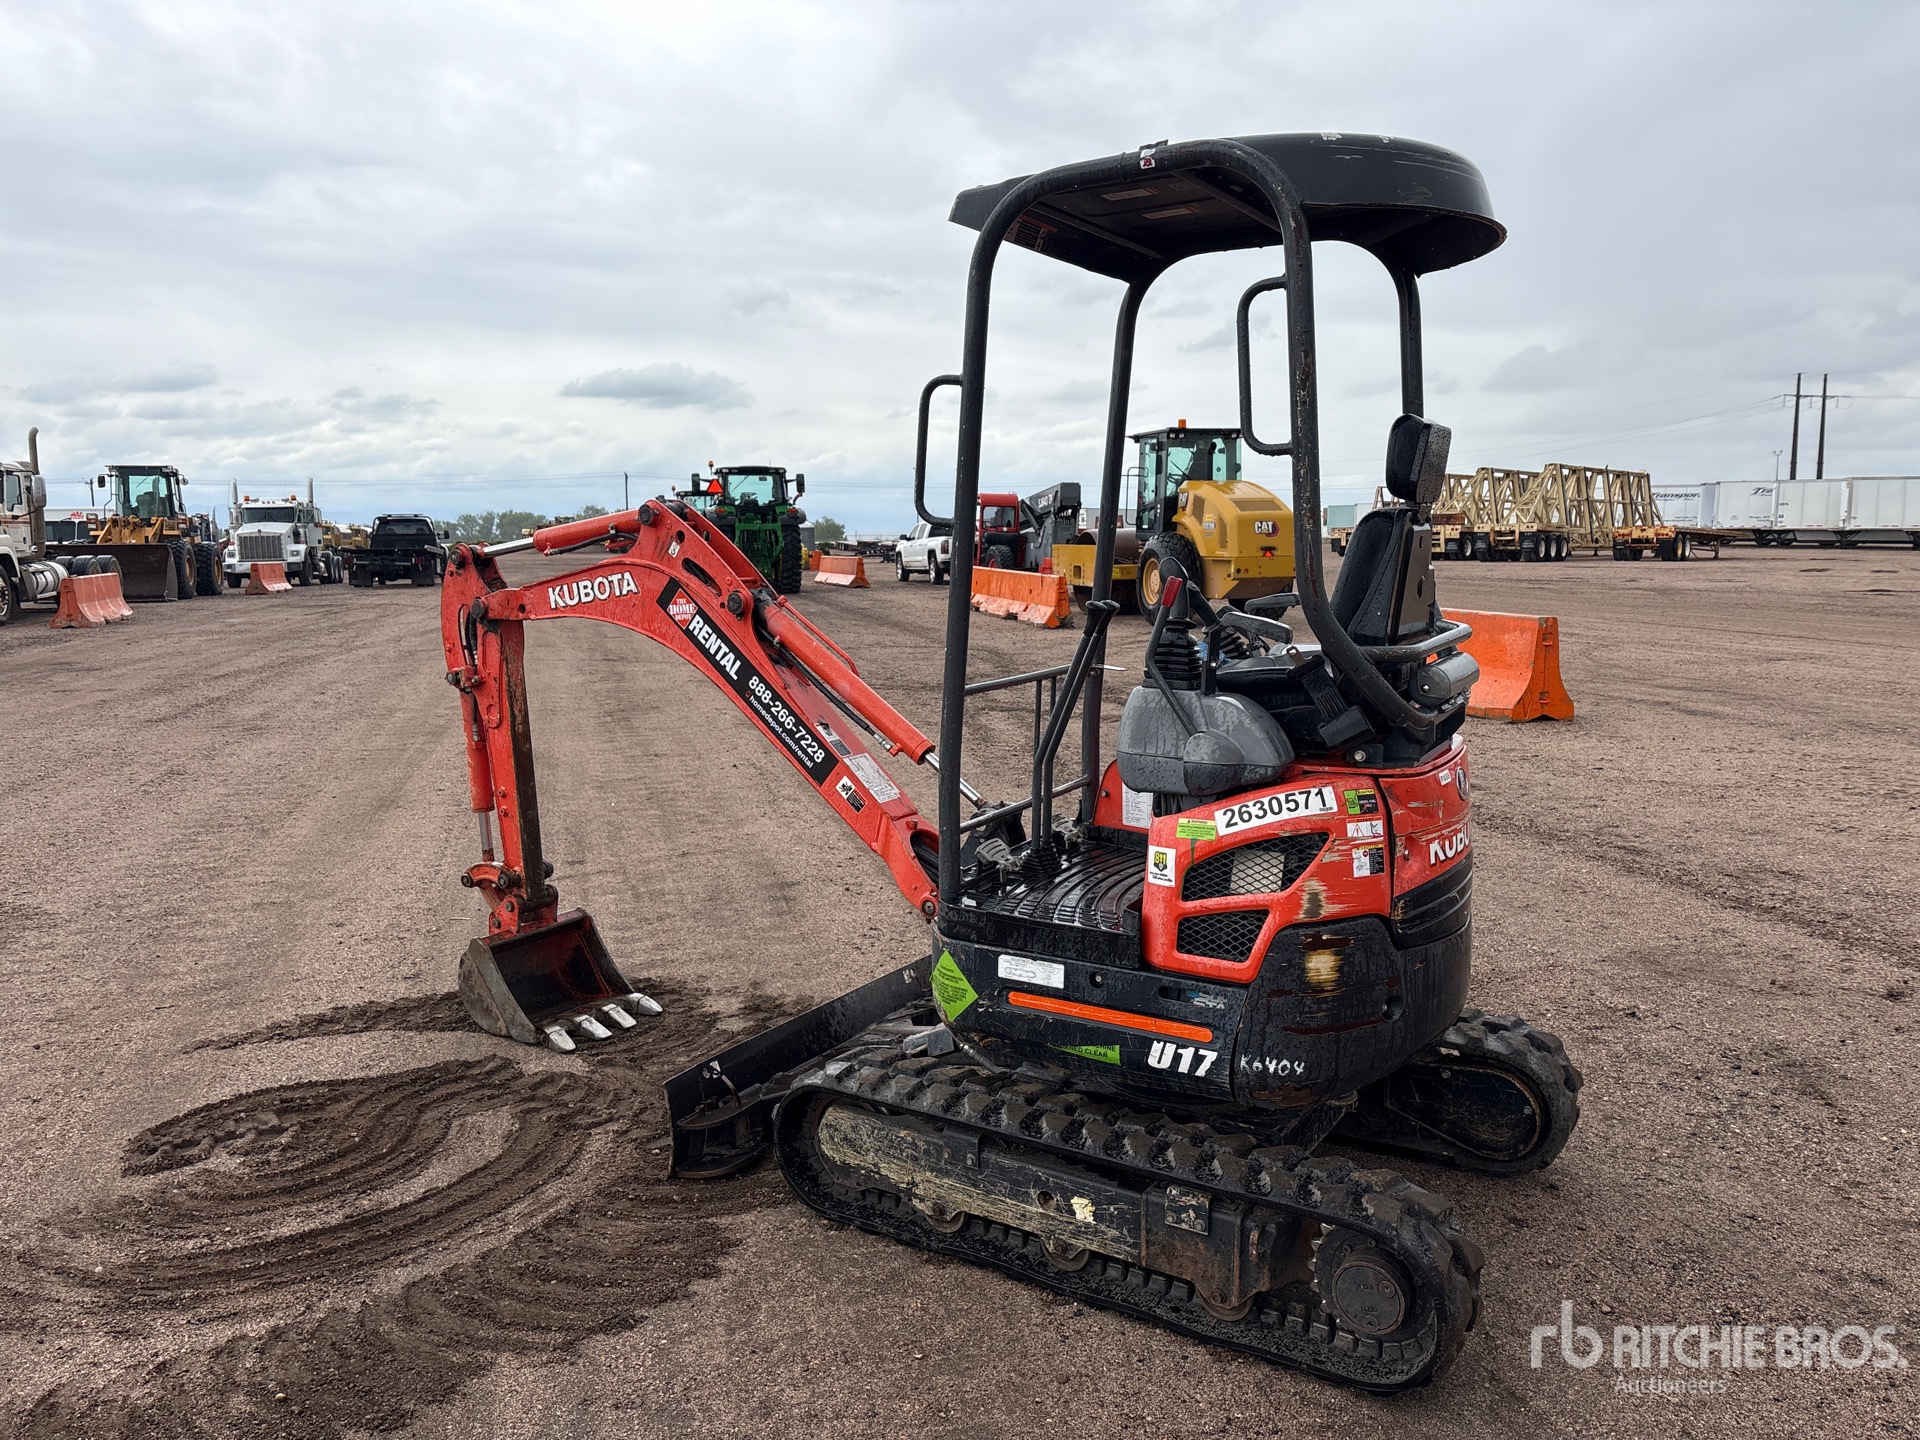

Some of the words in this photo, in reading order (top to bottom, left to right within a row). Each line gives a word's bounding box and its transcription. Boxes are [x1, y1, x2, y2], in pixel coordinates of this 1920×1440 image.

[1254, 521, 1273, 534] CAT
[547, 571, 640, 609] KUBOTA
[669, 604, 695, 614] HOME
[688, 614, 742, 681] RENTAL
[748, 675, 825, 763] 888-266-7228
[749, 695, 813, 768] homedepot.com/rental
[1222, 788, 1328, 828] 2630571
[1154, 851, 1167, 865] 811
[1084, 1048, 1108, 1058] CLEAN
[1147, 1040, 1218, 1077] U17
